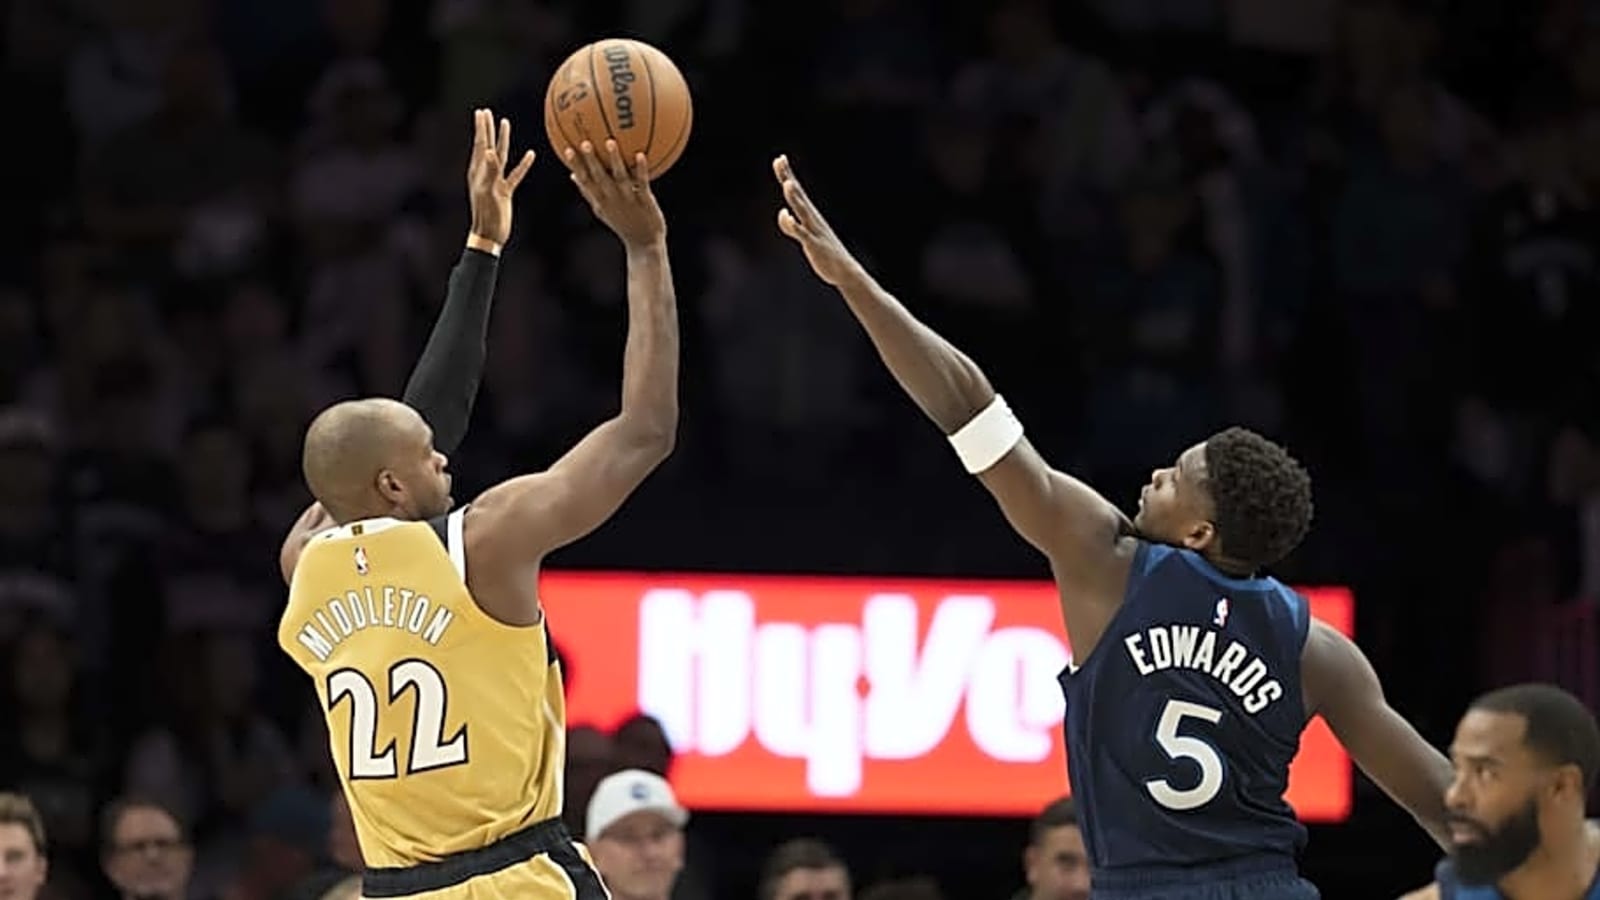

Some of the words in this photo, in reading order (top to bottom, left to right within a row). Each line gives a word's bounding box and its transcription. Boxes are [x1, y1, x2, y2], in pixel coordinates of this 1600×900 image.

[603, 45, 635, 129] Wilson
[297, 586, 454, 661] MIDDLETON
[1124, 624, 1283, 714] EDWARDS
[326, 657, 469, 780] 22
[1146, 699, 1224, 811] 5
